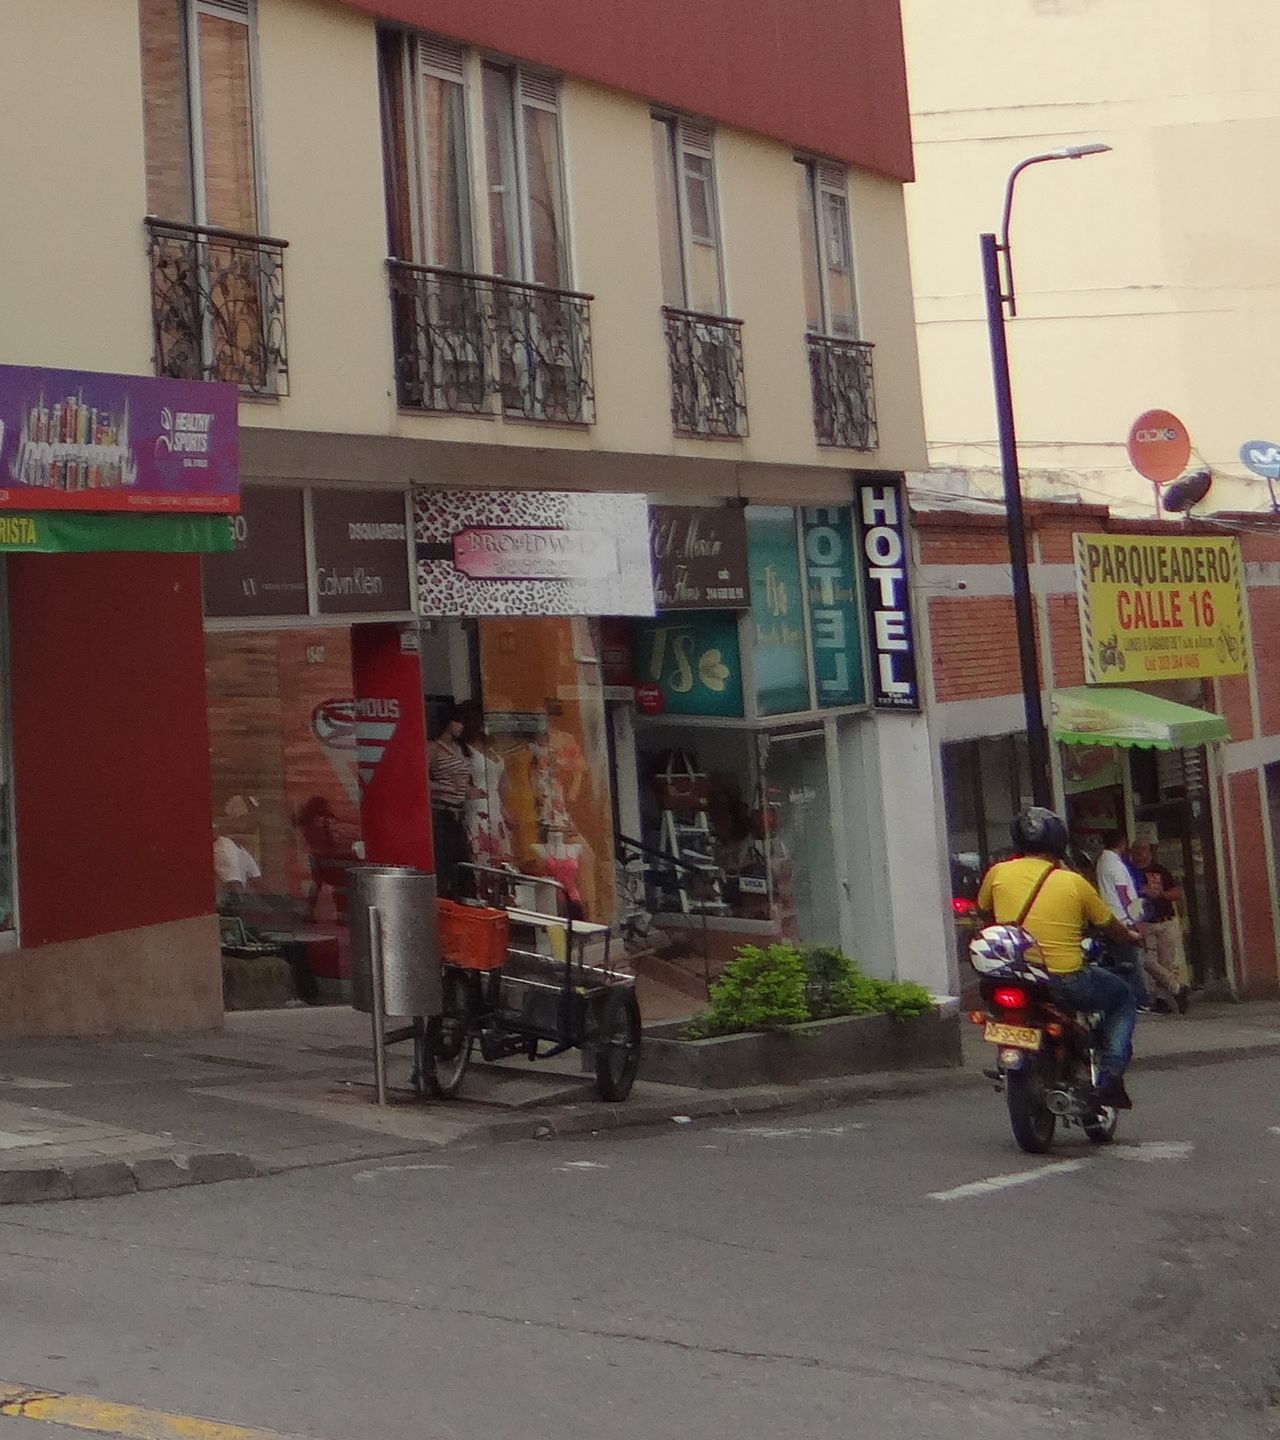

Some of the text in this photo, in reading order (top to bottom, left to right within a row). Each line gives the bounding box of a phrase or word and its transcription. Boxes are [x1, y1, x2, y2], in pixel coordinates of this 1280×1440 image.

[1087, 544, 1231, 586] PARQUEADERO
[861, 486, 911, 694] HOTEL
[1117, 590, 1215, 630] CALLE 16
